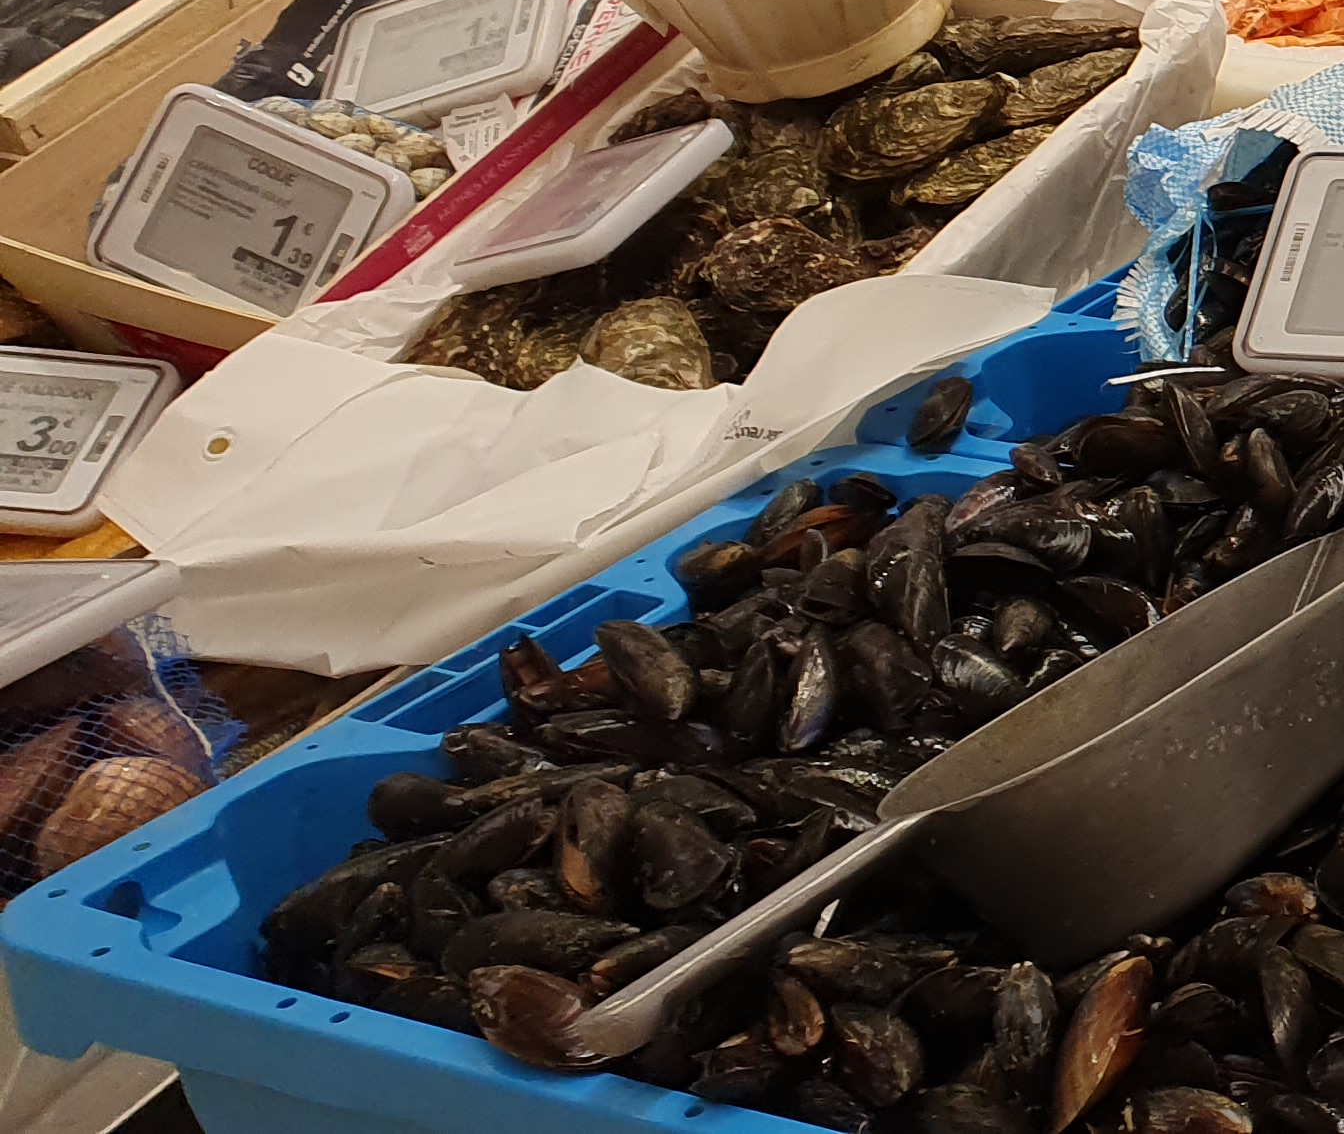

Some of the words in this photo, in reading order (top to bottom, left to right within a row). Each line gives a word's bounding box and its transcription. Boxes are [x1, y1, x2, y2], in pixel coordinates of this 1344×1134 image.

[247, 156, 299, 188] COQUE
[270, 214, 298, 258] 1
[16, 415, 60, 453] 3
